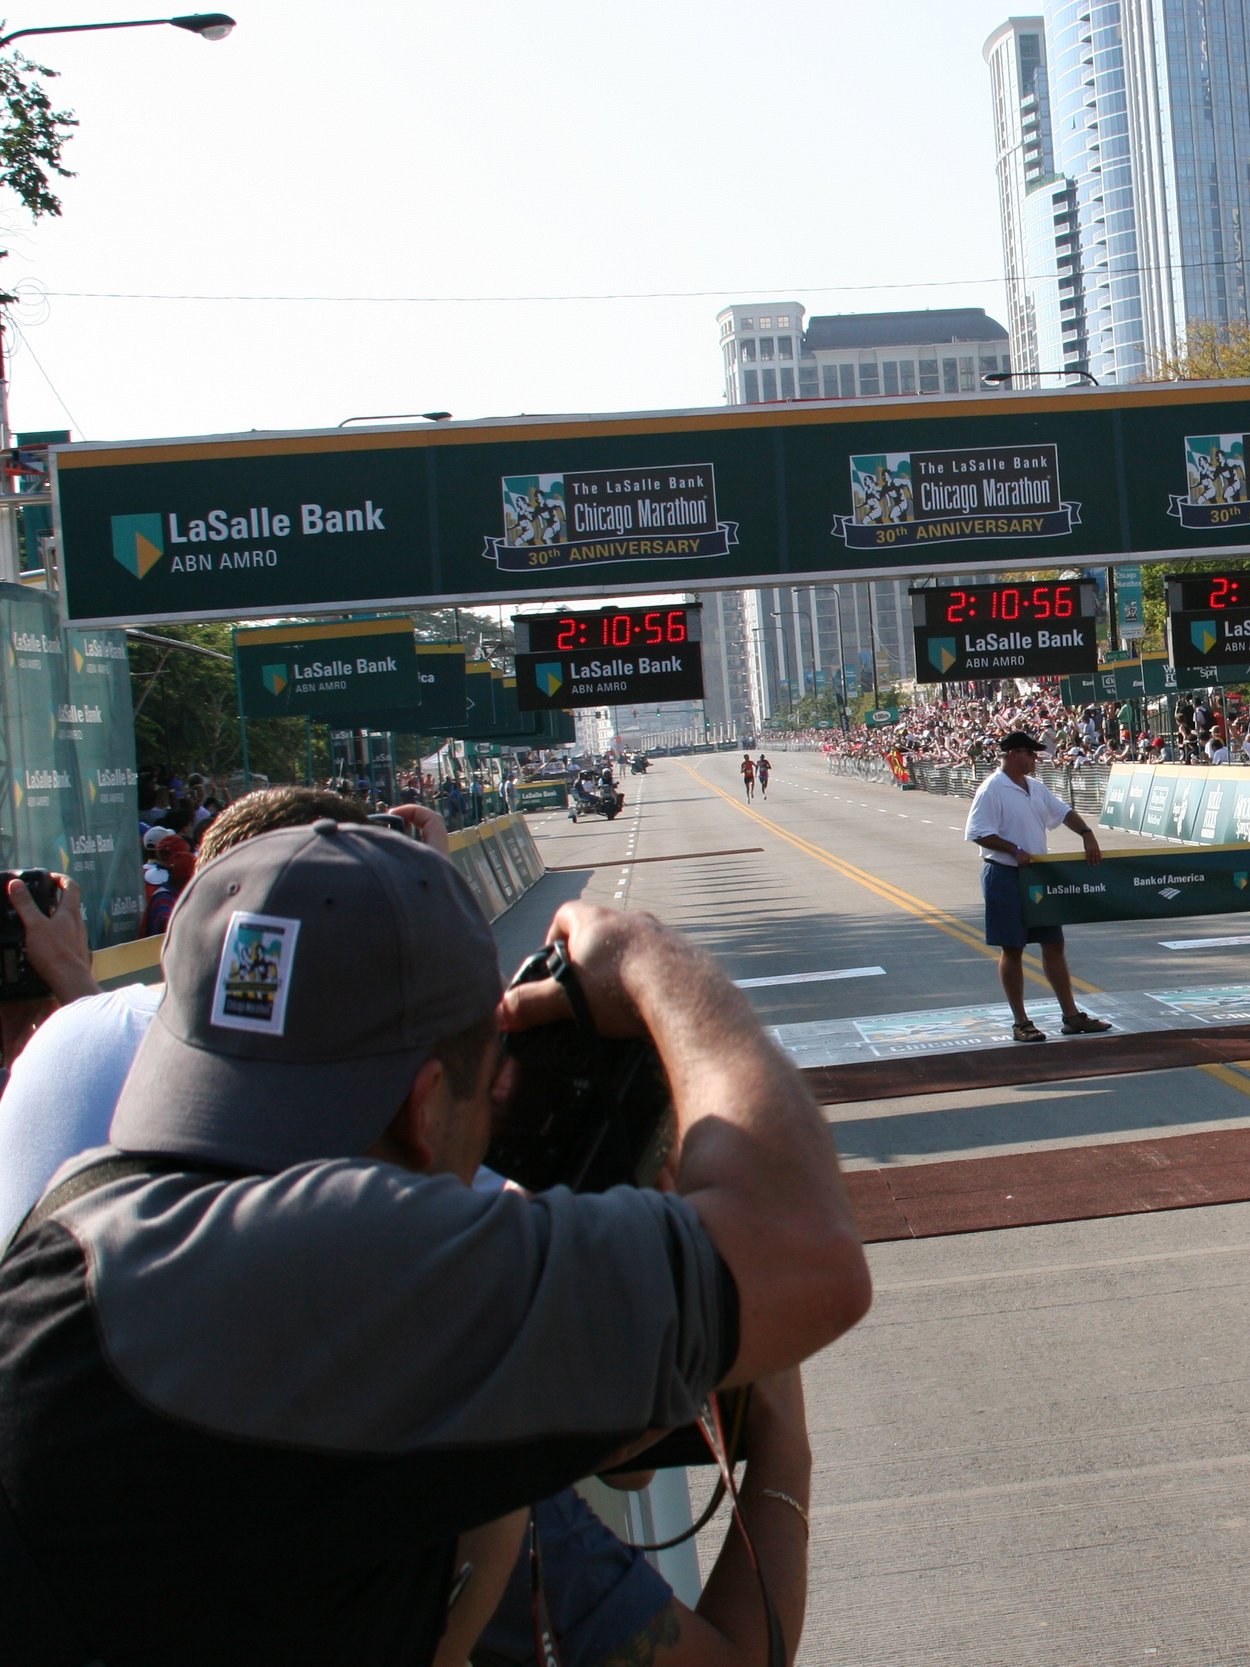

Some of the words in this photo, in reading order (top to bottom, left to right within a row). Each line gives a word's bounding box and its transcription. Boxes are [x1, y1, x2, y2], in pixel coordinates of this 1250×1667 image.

[920, 462, 944, 474] The
[952, 458, 1005, 473] LaSalle
[1013, 455, 1048, 469] Bank
[572, 483, 598, 495] The
[606, 478, 660, 493] LaSalle
[669, 475, 704, 489] Bank
[921, 482, 977, 513] Chicago
[983, 476, 1050, 507] Marathon
[169, 506, 291, 544] LaSalle
[301, 500, 385, 535] Bank
[574, 503, 632, 535] Chicago
[637, 497, 707, 528] Marathon
[1210, 506, 1241, 523] 30th
[876, 526, 908, 544] 30th
[916, 518, 1044, 540] ANNIVERSARY
[171, 553, 213, 573] ABN
[220, 549, 277, 569] AMRO
[528, 548, 561, 566] 30th
[569, 538, 701, 561] ANNIVERSARY
[965, 632, 1032, 653] LaSalle
[1038, 629, 1084, 648] Bank
[1225, 642, 1245, 652] ABN
[293, 659, 352, 680] LaSalle
[357, 656, 397, 674] Bank
[570, 658, 634, 680] LaSalle
[638, 655, 682, 674] Bank
[966, 657, 989, 669] ABN
[993, 655, 1024, 667] AMRO
[296, 682, 316, 693] ABN
[320, 680, 347, 691] AMRO
[572, 683, 593, 694] ABN
[597, 681, 627, 692] AMRO
[97, 768, 127, 787] LaSalle
[1046, 884, 1081, 896] LaSalle
[1083, 883, 1106, 893] Bank
